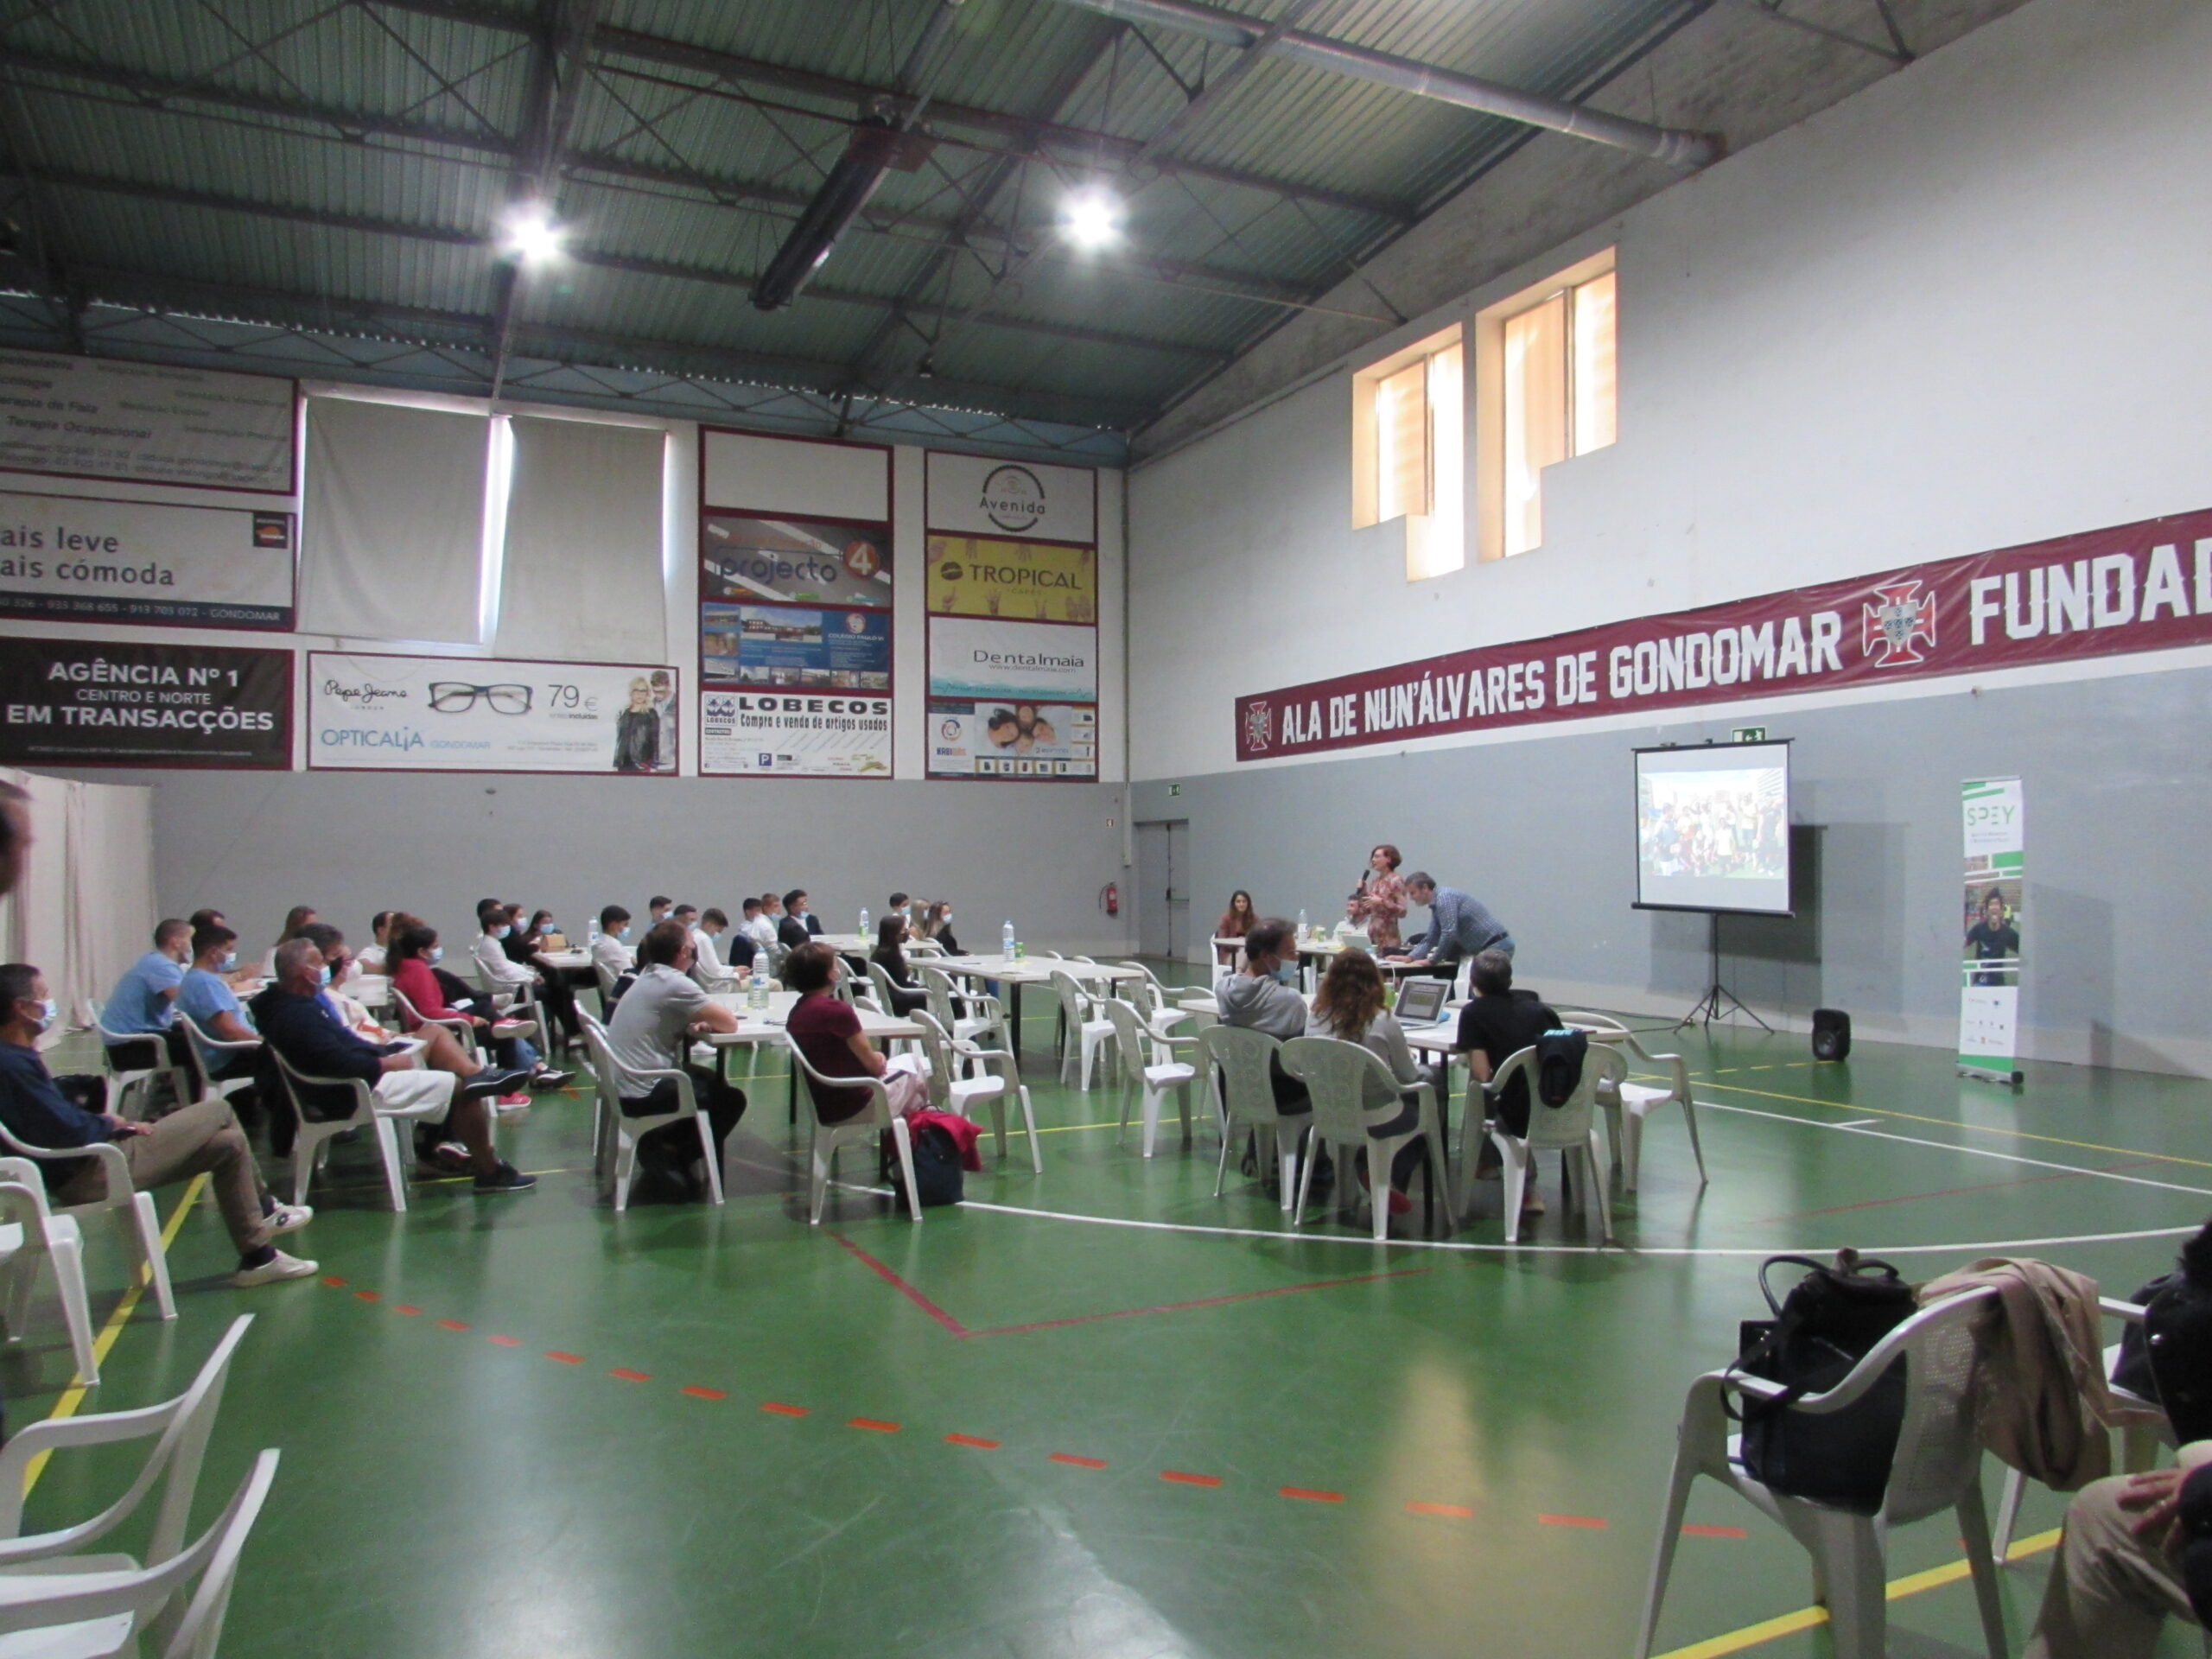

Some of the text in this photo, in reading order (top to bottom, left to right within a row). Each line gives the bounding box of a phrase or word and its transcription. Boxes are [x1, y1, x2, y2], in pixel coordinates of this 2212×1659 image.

[979, 496, 1046, 515] Avenida
[0, 526, 119, 553] ais leve
[0, 555, 175, 586] ais cómoda
[721, 543, 872, 590] projecto 4
[969, 563, 1083, 590] TROPICAL
[210, 608, 281, 621] GONDOMAR
[48, 658, 181, 686] AGÊNCIA
[226, 669, 238, 688] 1
[1281, 701, 1322, 746] ALA
[1330, 692, 1357, 738] DE
[1556, 650, 1598, 707] DE
[1610, 610, 1843, 699] GONDOMAR
[76, 689, 212, 705] CENTRO E NORTE
[739, 696, 888, 715] LOBECOS
[7, 704, 274, 734] EM TRANSACÇÕES
[741, 713, 888, 733] Compra e venda de artigos usados
[1967, 805, 2016, 826] SPEY
